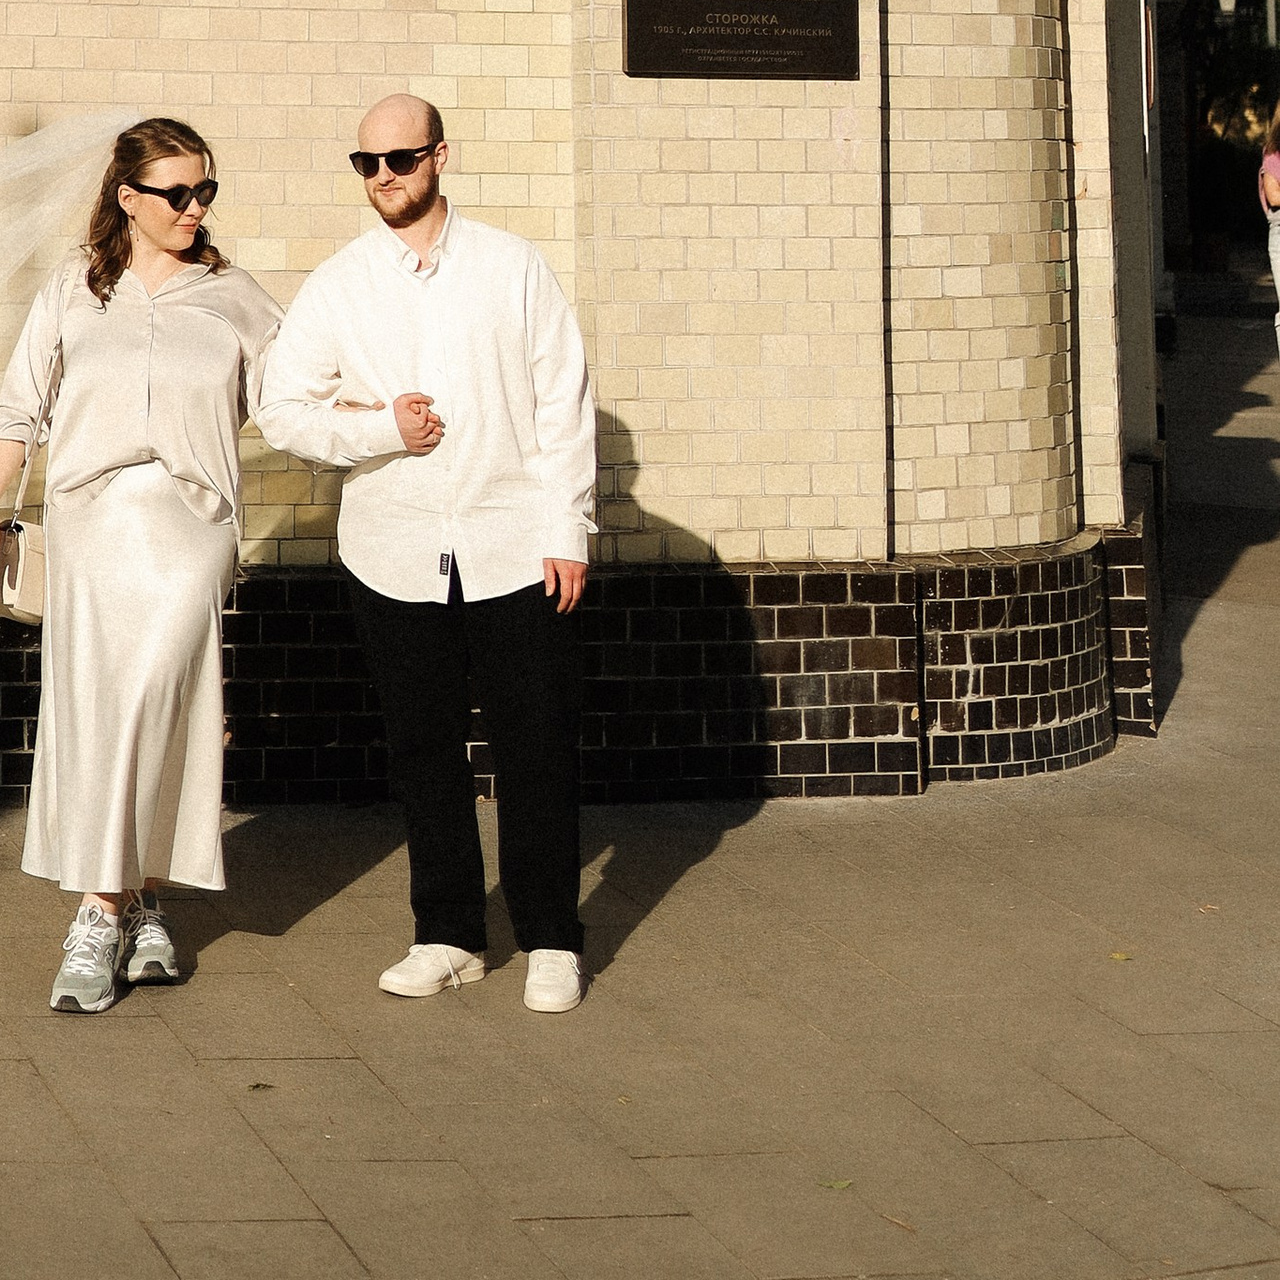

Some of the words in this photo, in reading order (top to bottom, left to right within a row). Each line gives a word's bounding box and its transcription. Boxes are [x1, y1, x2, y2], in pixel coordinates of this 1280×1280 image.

[706, 13, 779, 25] СТОРОЖКА
[653, 25, 674, 34] 1905
[688, 26, 751, 36] АРХИТЕКТОР
[774, 27, 832, 37] КУЧИНСКИЙ
